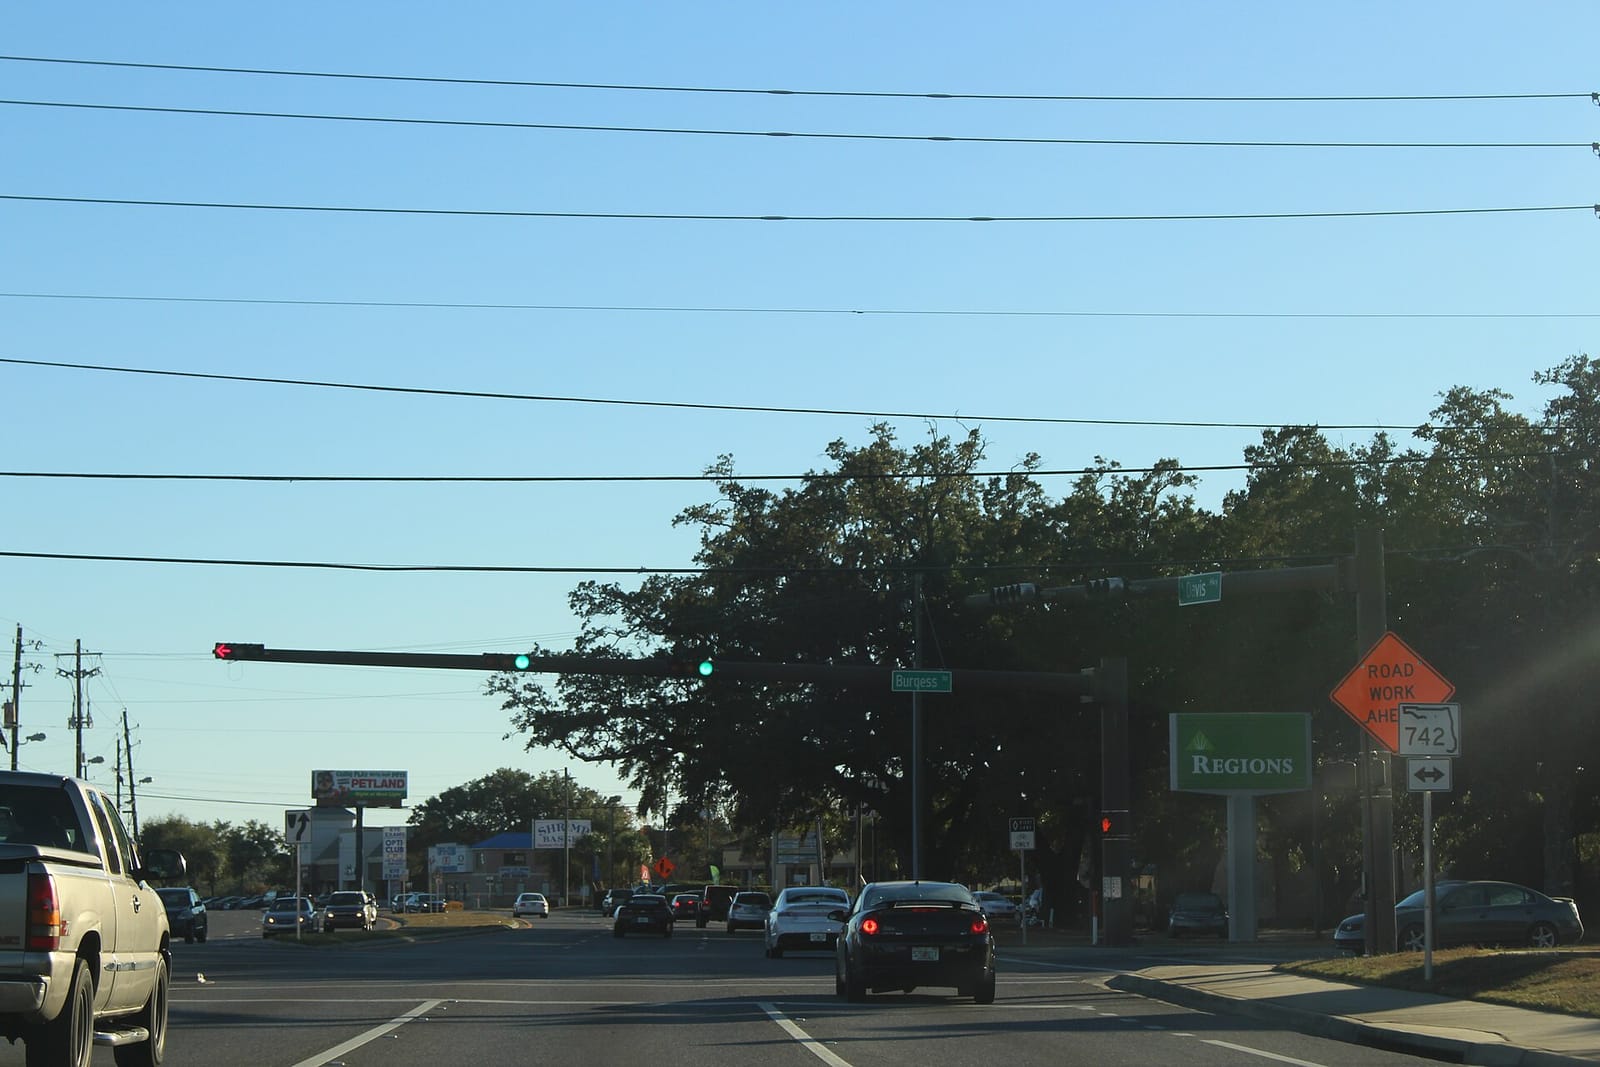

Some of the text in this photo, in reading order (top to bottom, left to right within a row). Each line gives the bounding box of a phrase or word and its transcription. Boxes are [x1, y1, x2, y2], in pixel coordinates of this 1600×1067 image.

[1186, 580, 1206, 598] Davis
[1368, 663, 1414, 679] ROAD
[896, 675, 938, 689] Burgess
[1369, 685, 1415, 701] WORK
[1367, 708, 1398, 723] AHE
[1405, 727, 1445, 746] 742
[1191, 755, 1294, 774] REGIONS
[351, 778, 405, 789] PETLAND
[537, 822, 590, 834] SHRMP
